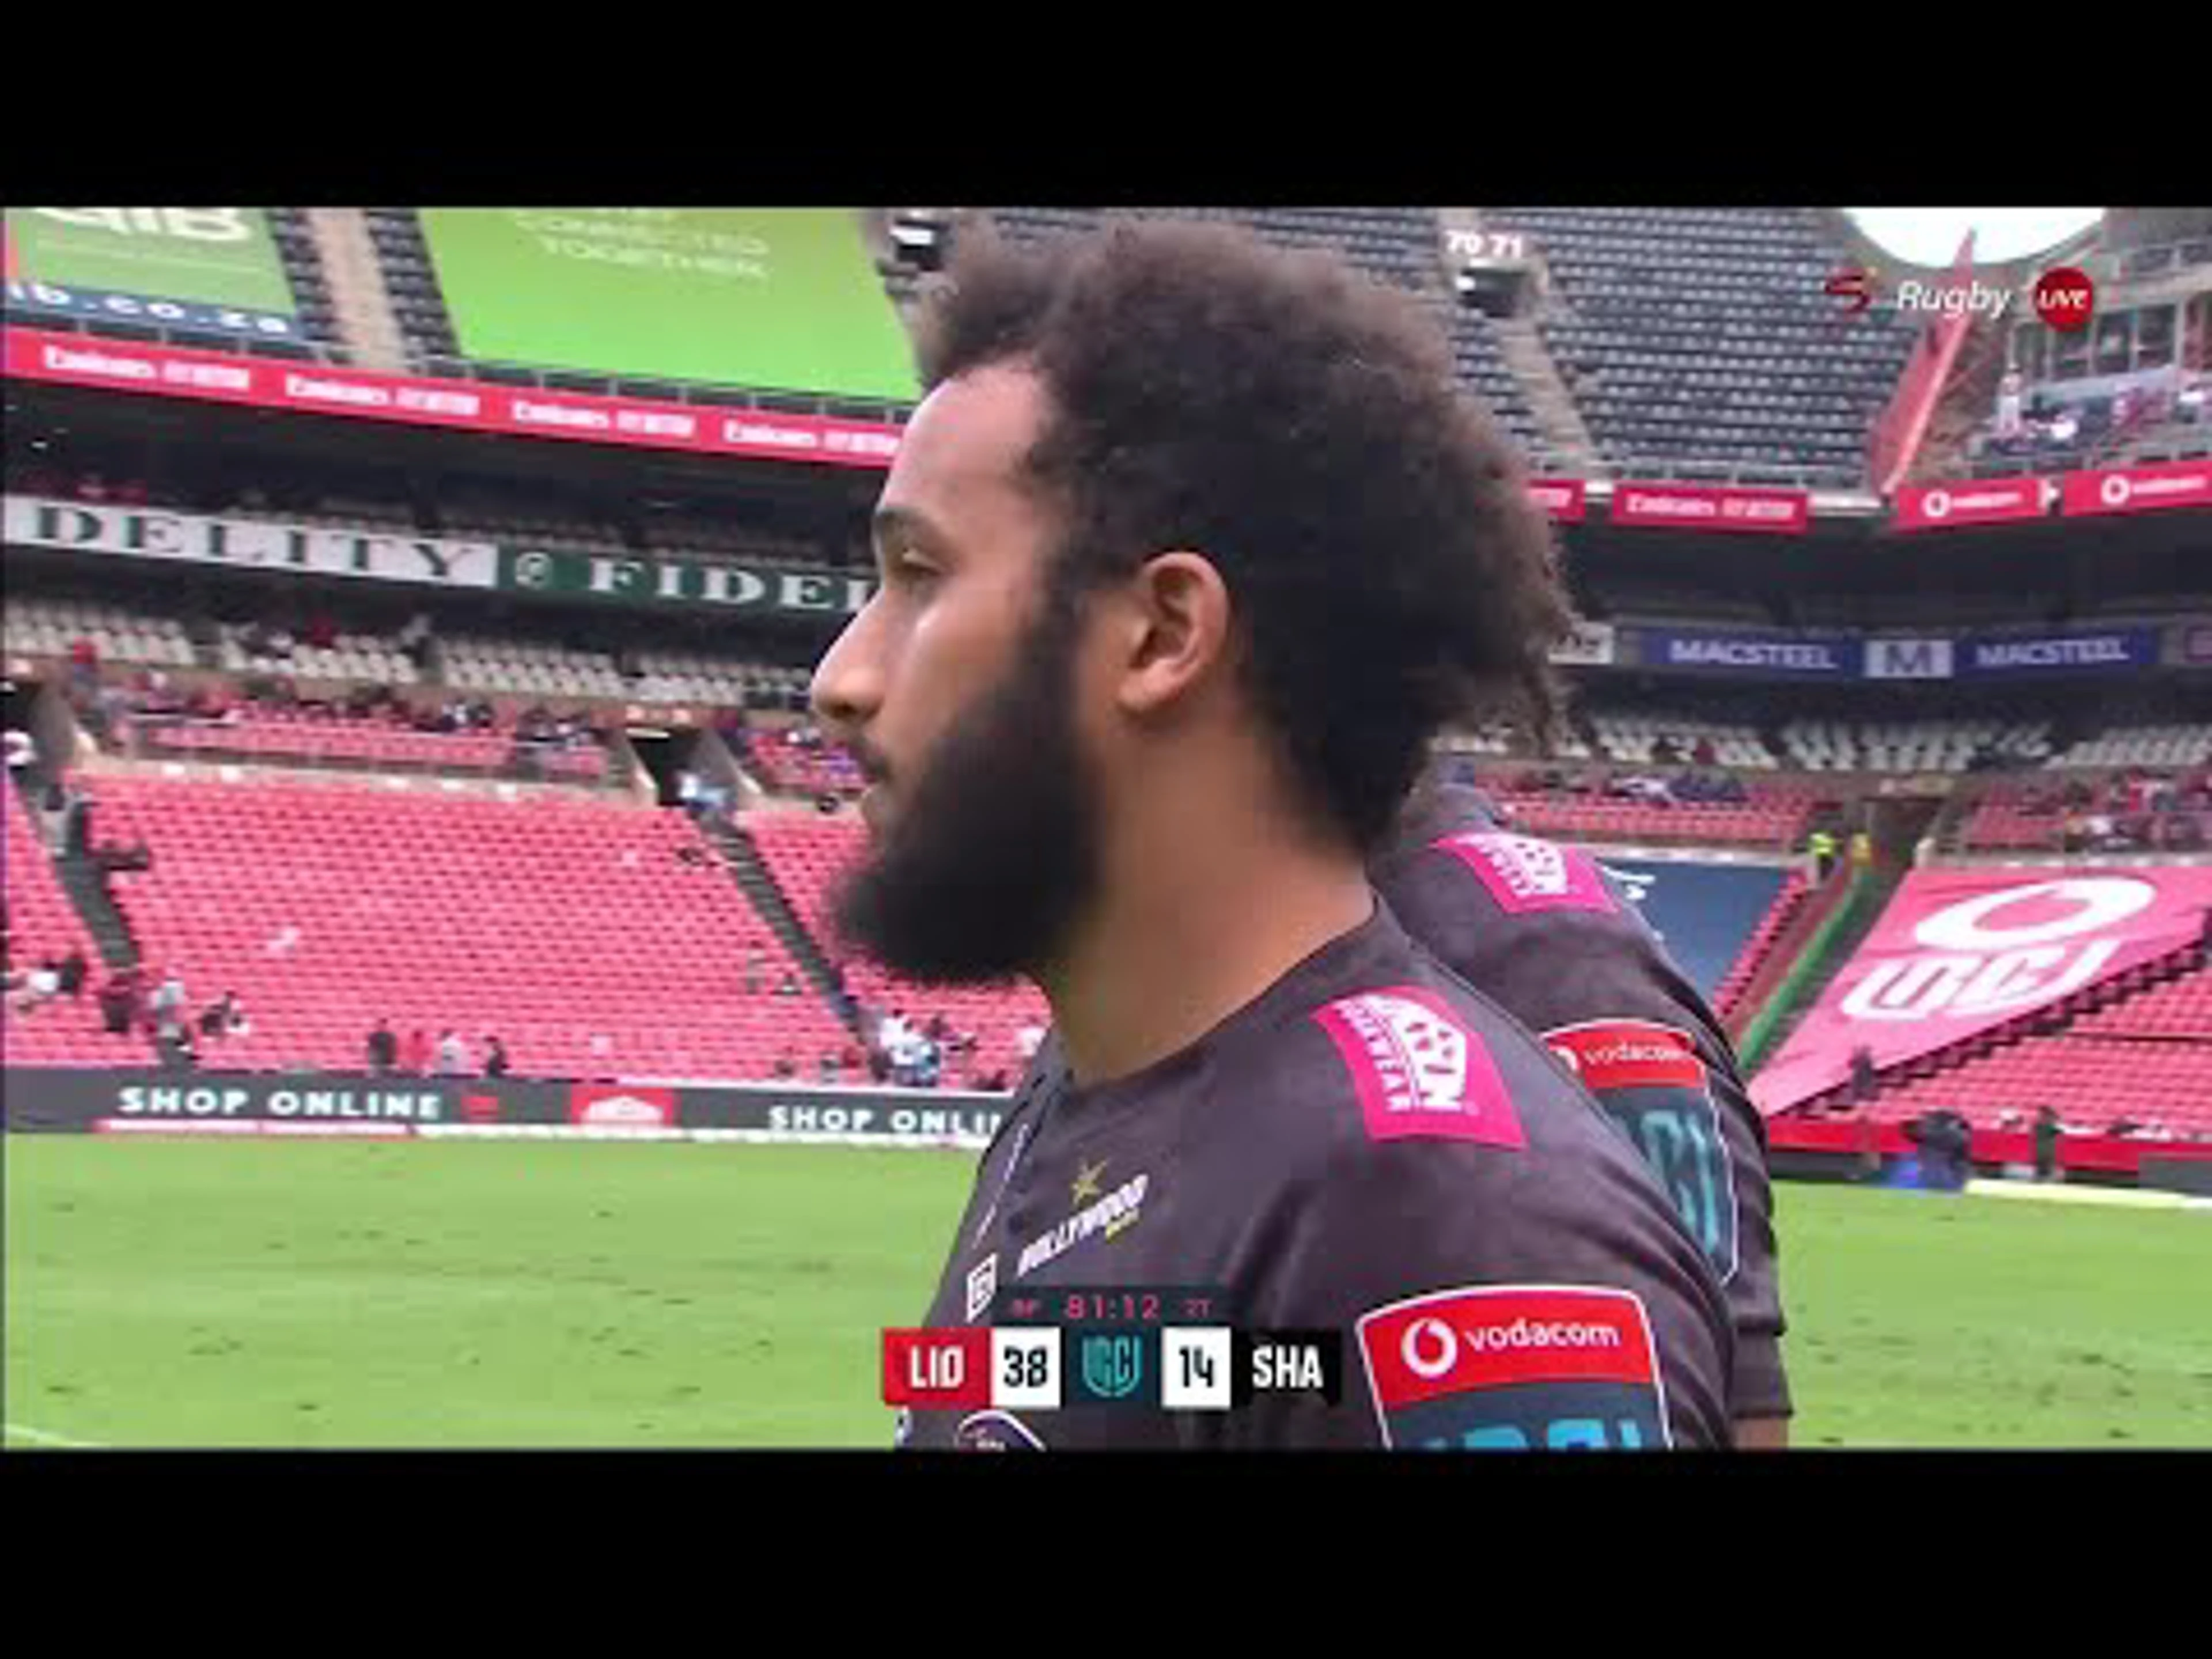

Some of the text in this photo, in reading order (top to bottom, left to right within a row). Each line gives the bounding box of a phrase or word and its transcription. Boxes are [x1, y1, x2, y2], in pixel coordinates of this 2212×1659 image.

[1446, 230, 1523, 259] 70 71
[1669, 639, 1839, 670] MACSTEEL
[1885, 643, 1932, 674] M
[1975, 636, 2130, 668] MACSTEEL
[119, 1086, 248, 1114] SHOP
[268, 1090, 440, 1119] ONLINE
[768, 1105, 873, 1131] SHOP
[1465, 1318, 1622, 1352] vodacom
